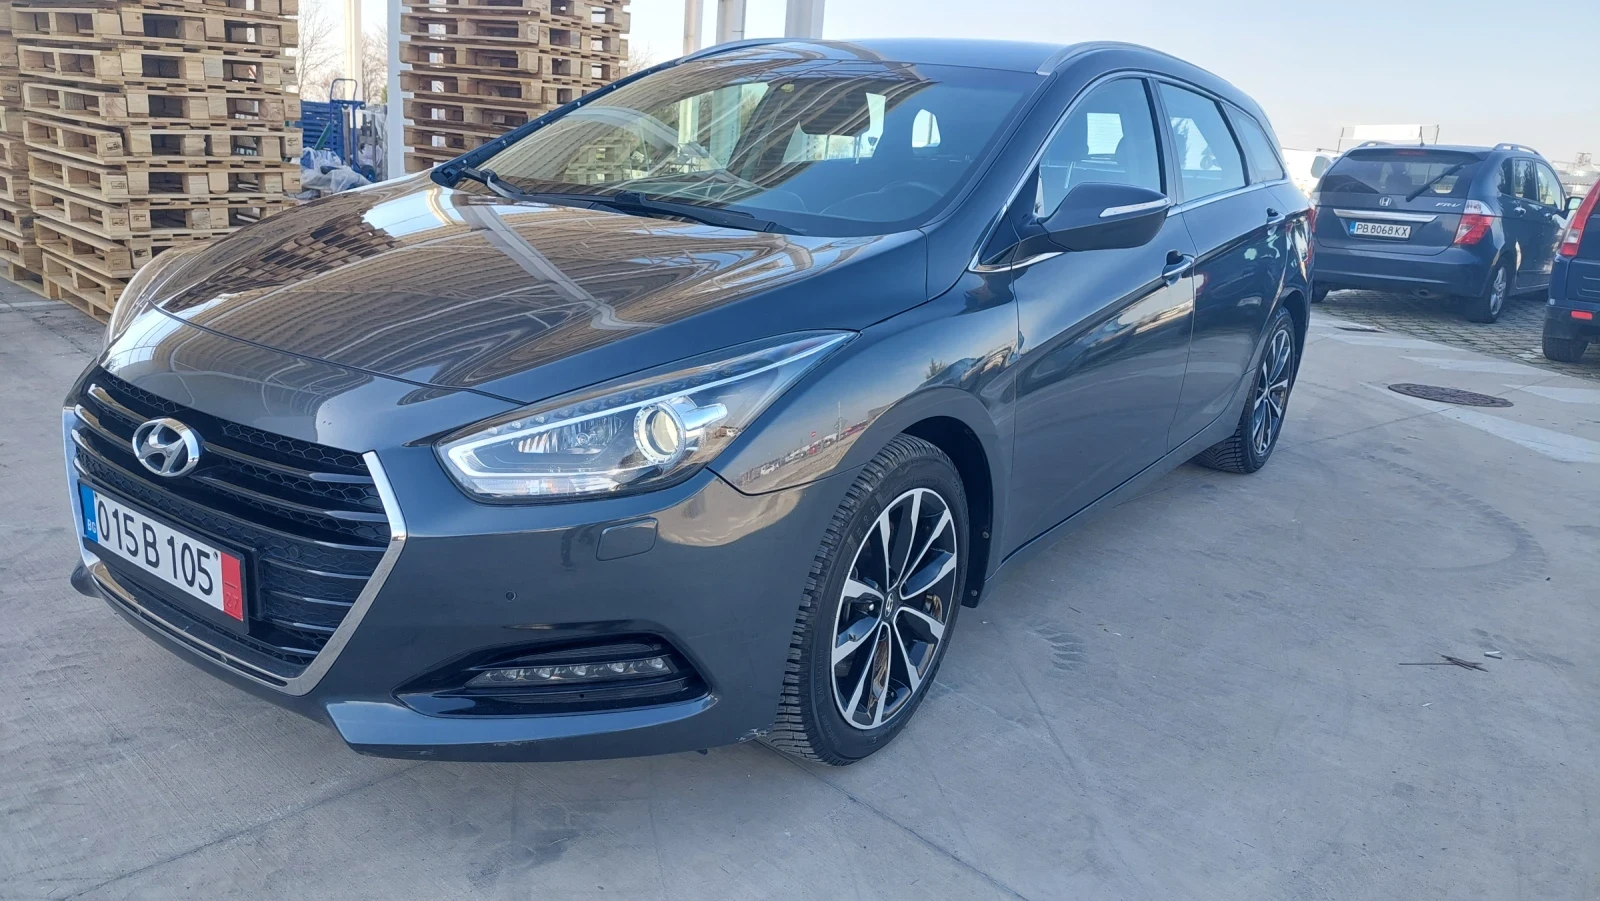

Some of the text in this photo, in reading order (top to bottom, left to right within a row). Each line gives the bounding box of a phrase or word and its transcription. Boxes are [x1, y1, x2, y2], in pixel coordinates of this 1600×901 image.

[1356, 224, 1409, 237] PB 8068 KX
[88, 518, 97, 533] BG
